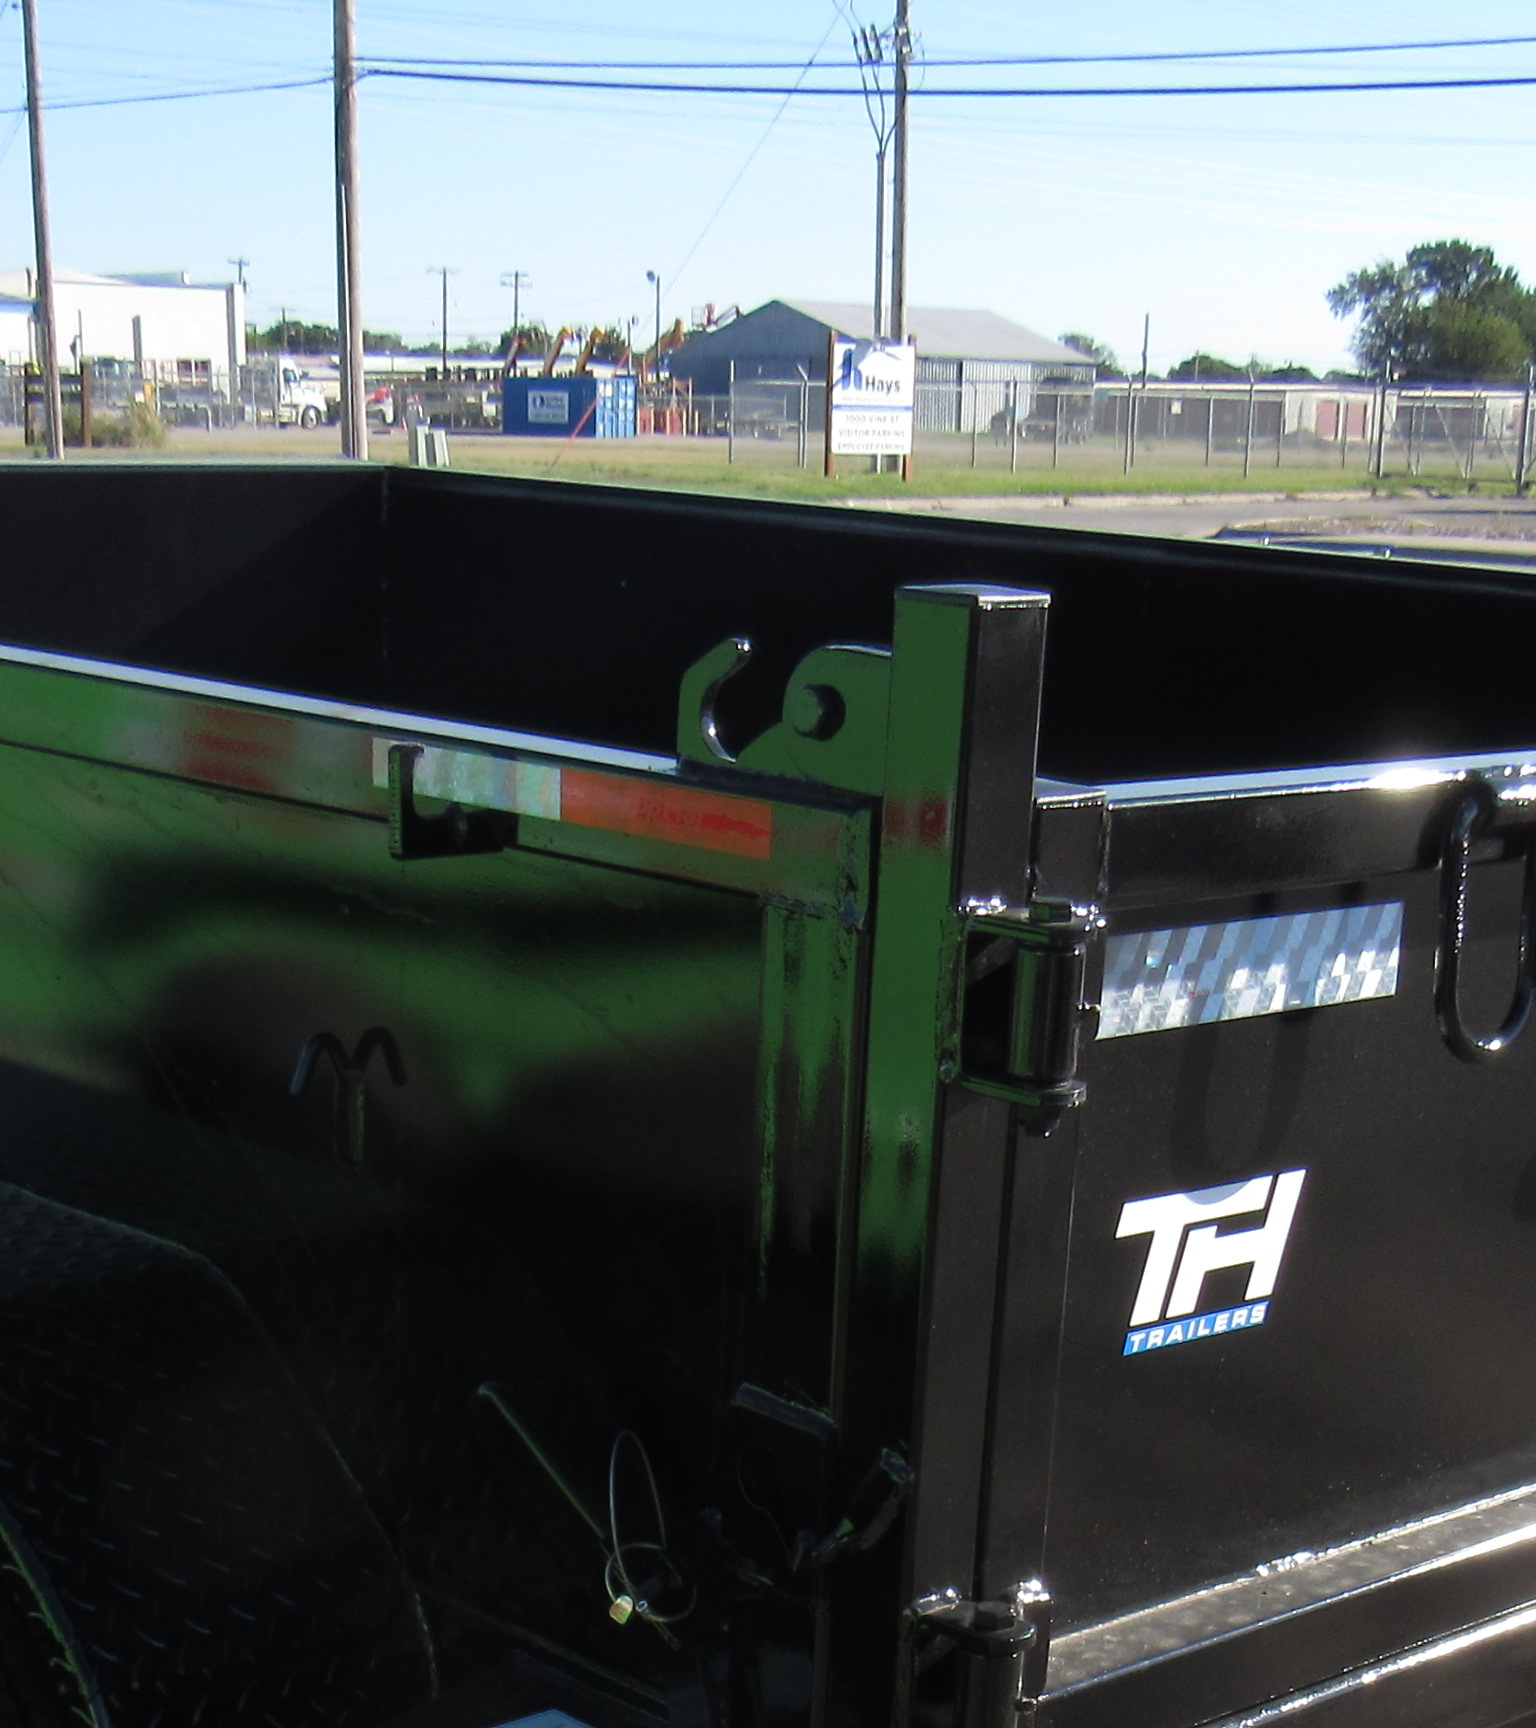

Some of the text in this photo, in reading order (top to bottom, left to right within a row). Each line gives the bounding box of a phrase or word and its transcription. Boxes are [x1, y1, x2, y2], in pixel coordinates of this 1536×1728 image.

[865, 374, 901, 396] Hays
[1115, 1168, 1307, 1327] TH
[1129, 1305, 1267, 1353] TRAILERS
